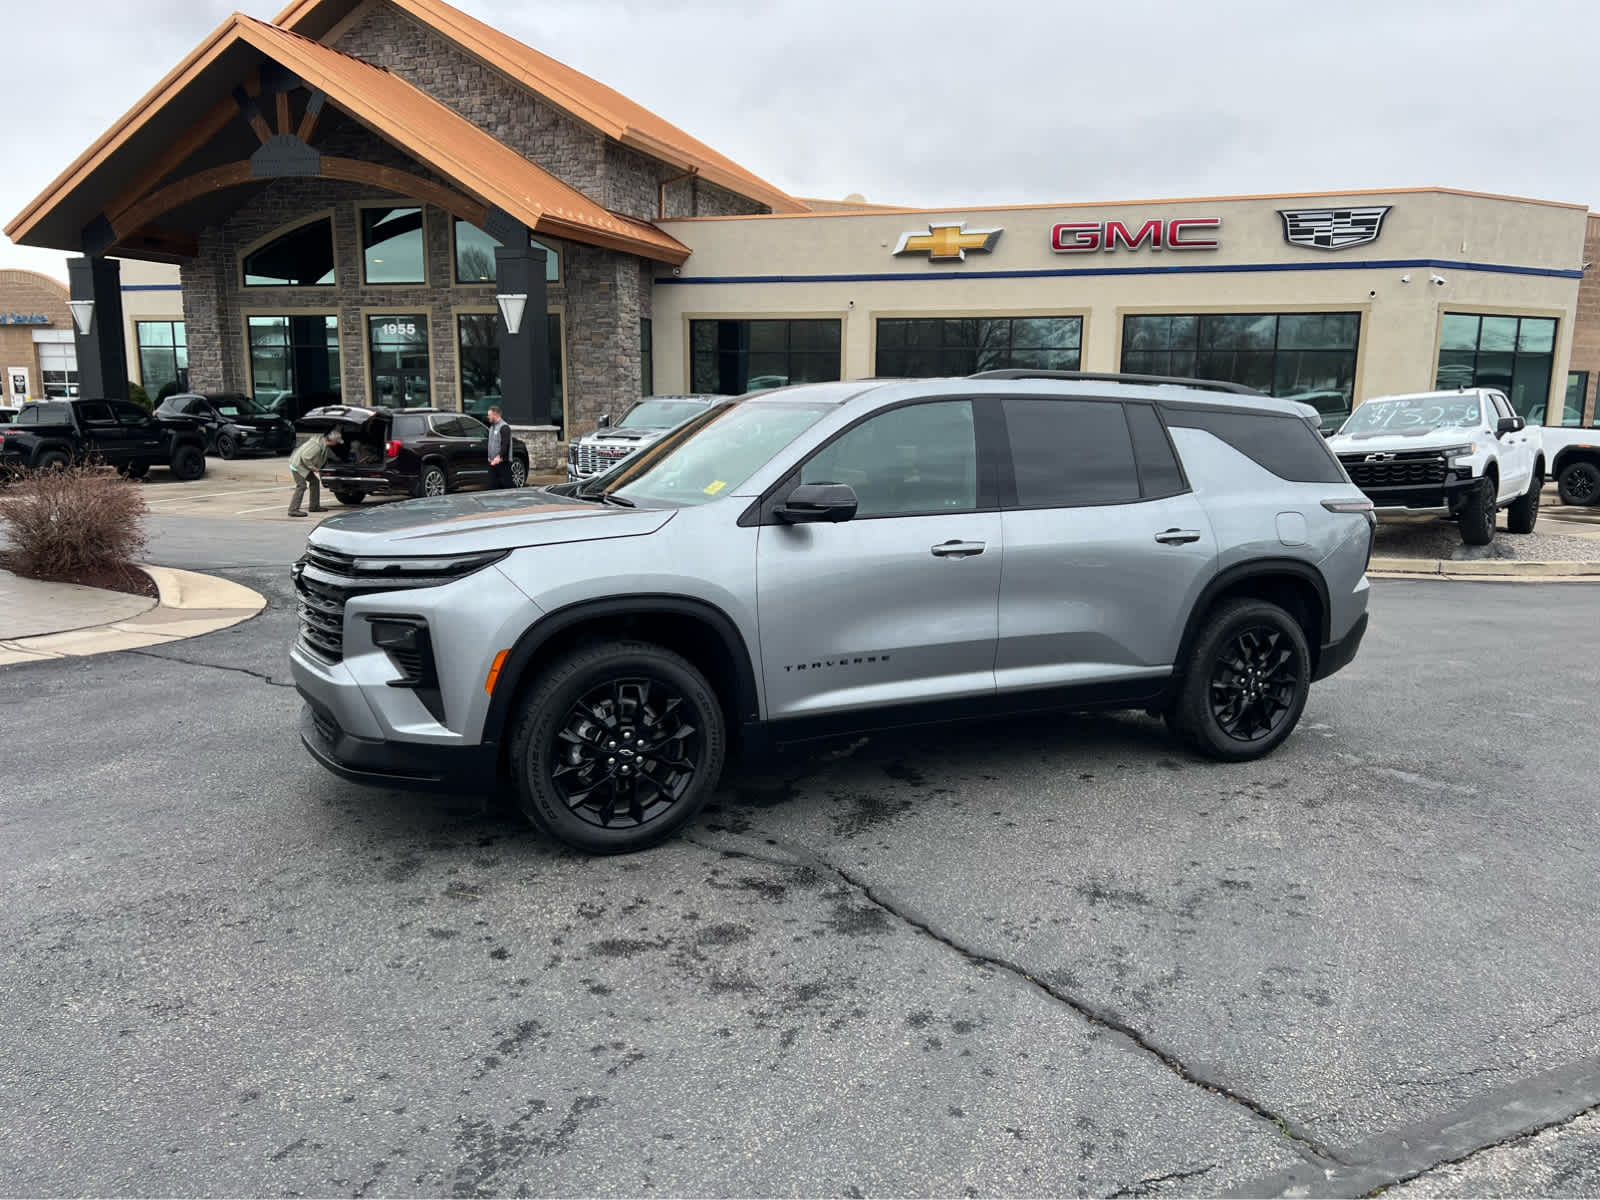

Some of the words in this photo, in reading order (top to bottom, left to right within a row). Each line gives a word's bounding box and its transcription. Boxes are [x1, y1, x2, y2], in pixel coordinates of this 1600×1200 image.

[1051, 217, 1221, 254] GMC
[382, 323, 416, 335] 1955
[784, 655, 890, 672] TRAVERSE
